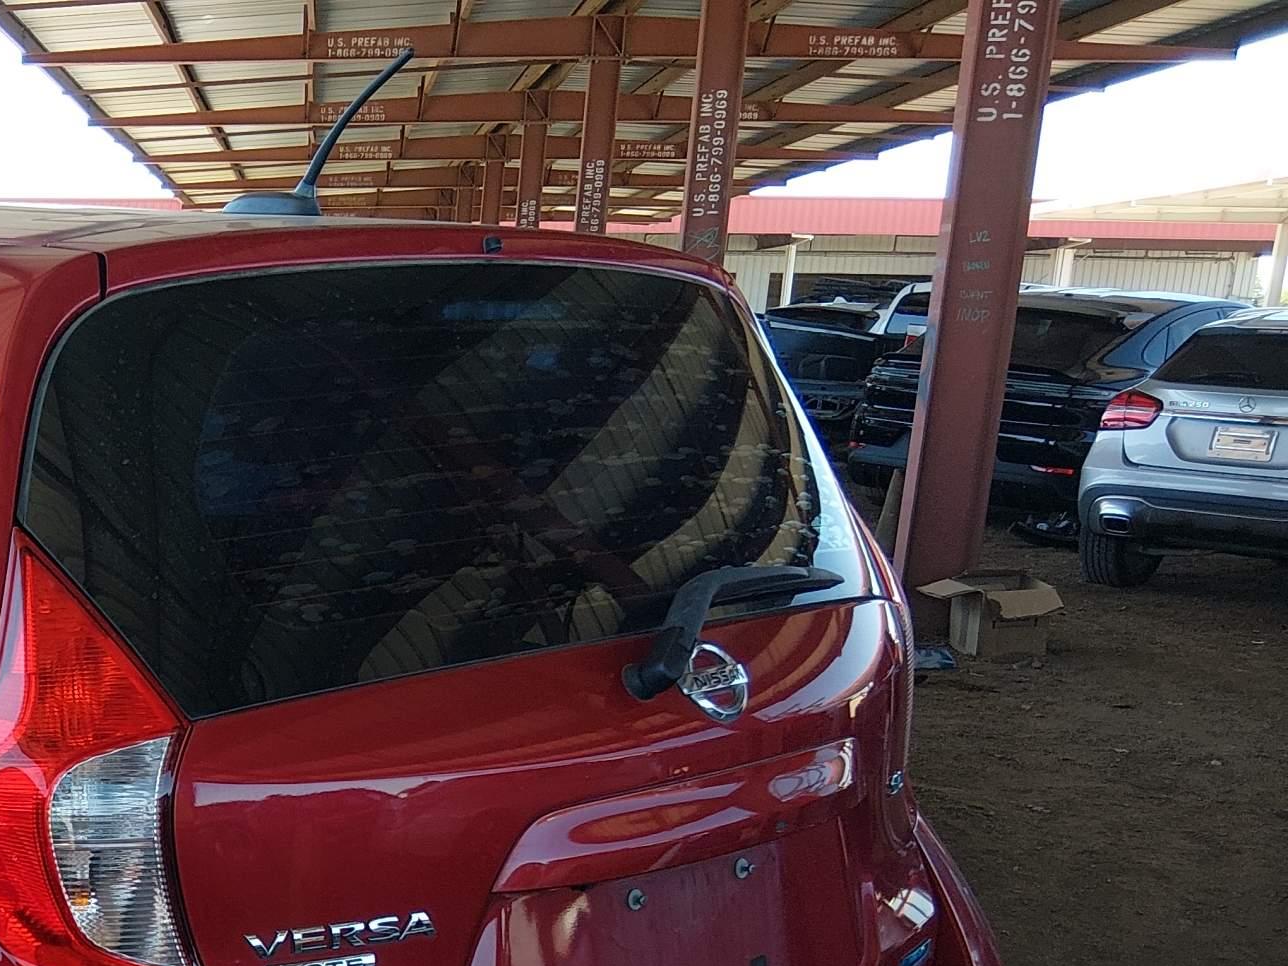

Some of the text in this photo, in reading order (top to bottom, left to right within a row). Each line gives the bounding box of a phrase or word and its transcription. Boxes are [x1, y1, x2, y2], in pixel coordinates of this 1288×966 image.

[327, 38, 346, 48] U.S.
[351, 37, 390, 47] PREFAB
[833, 34, 874, 46] PREFAB
[696, 124, 711, 181] PREFAB
[580, 183, 593, 224] PREFAB
[692, 662, 746, 690] NISSAN
[243, 911, 437, 958] VERSA
